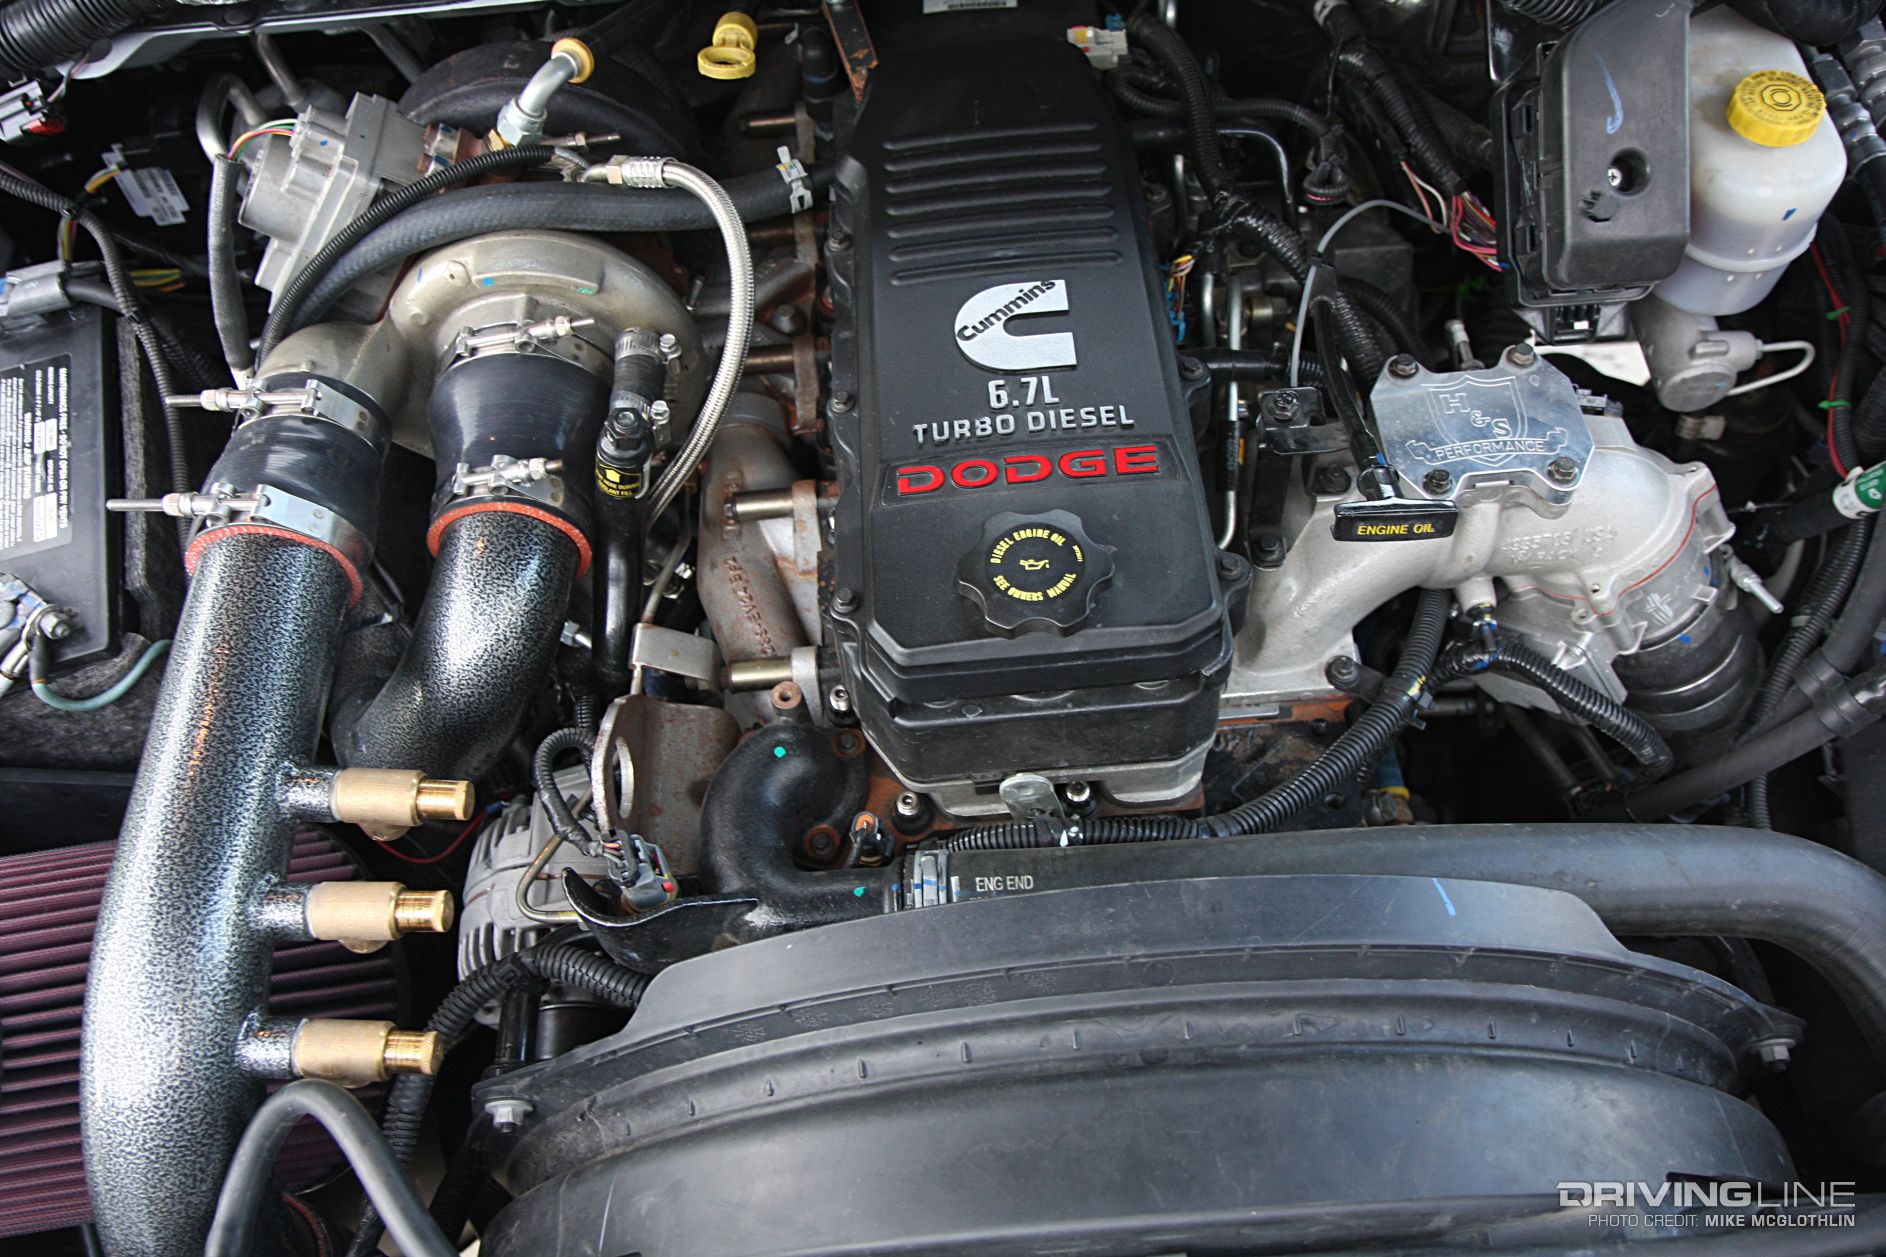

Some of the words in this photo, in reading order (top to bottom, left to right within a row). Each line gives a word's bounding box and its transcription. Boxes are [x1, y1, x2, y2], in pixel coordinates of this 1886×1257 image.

[955, 279, 1056, 342] Cummins
[988, 375, 1060, 410] 6.7L
[912, 414, 1016, 444] TURBO
[1027, 405, 1135, 433] DIESEL
[1434, 440, 1546, 461] PERFORMANCE
[896, 445, 1160, 496] DODGE
[990, 537, 1014, 564] DIESEL
[1012, 528, 1051, 541] ENGINE
[1050, 533, 1066, 547] OIL
[1357, 524, 1409, 535] ENGINE
[1413, 523, 1435, 534] OIL
[993, 575, 1011, 591] SEE
[1046, 573, 1077, 598] MANUAL
[975, 876, 1004, 892] ENG
[1006, 874, 1034, 891] END
